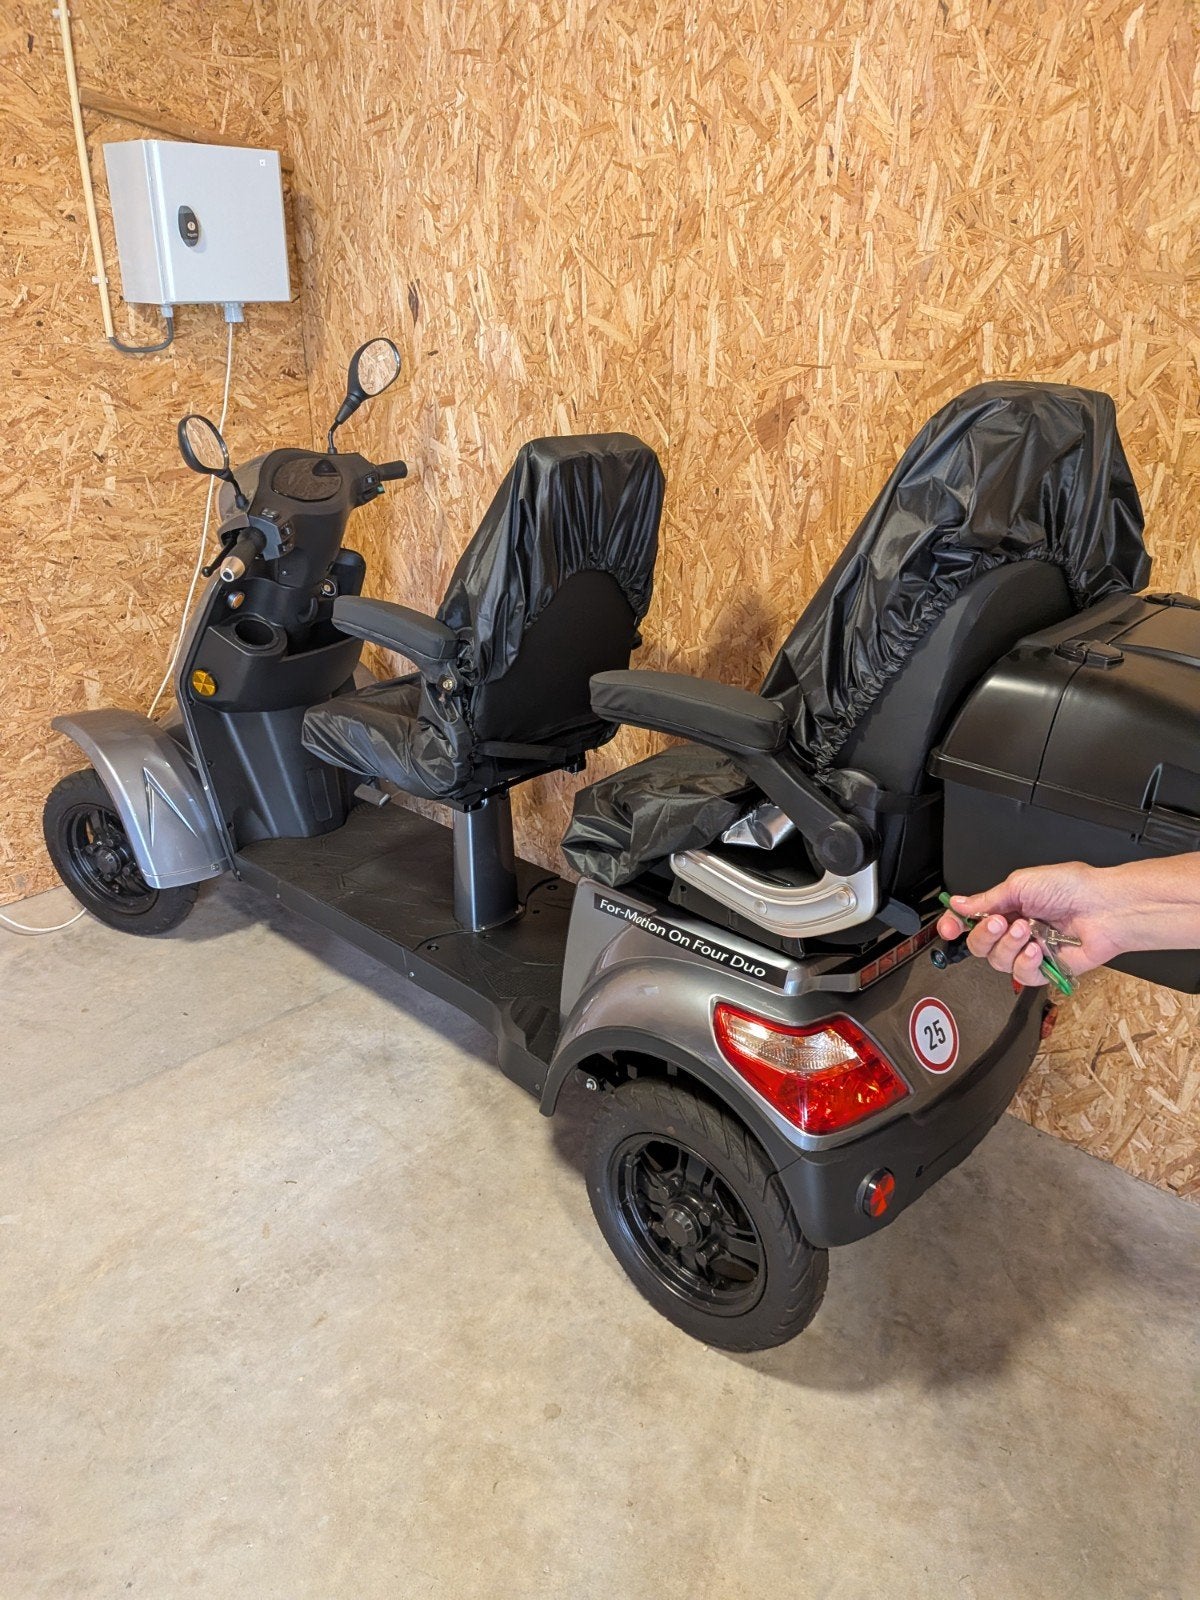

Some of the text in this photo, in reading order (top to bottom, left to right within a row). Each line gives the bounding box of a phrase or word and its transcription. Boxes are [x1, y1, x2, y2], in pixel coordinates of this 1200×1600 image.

[600, 899, 766, 977] For-Motion On Four Duo
[924, 1019, 946, 1050] 25
